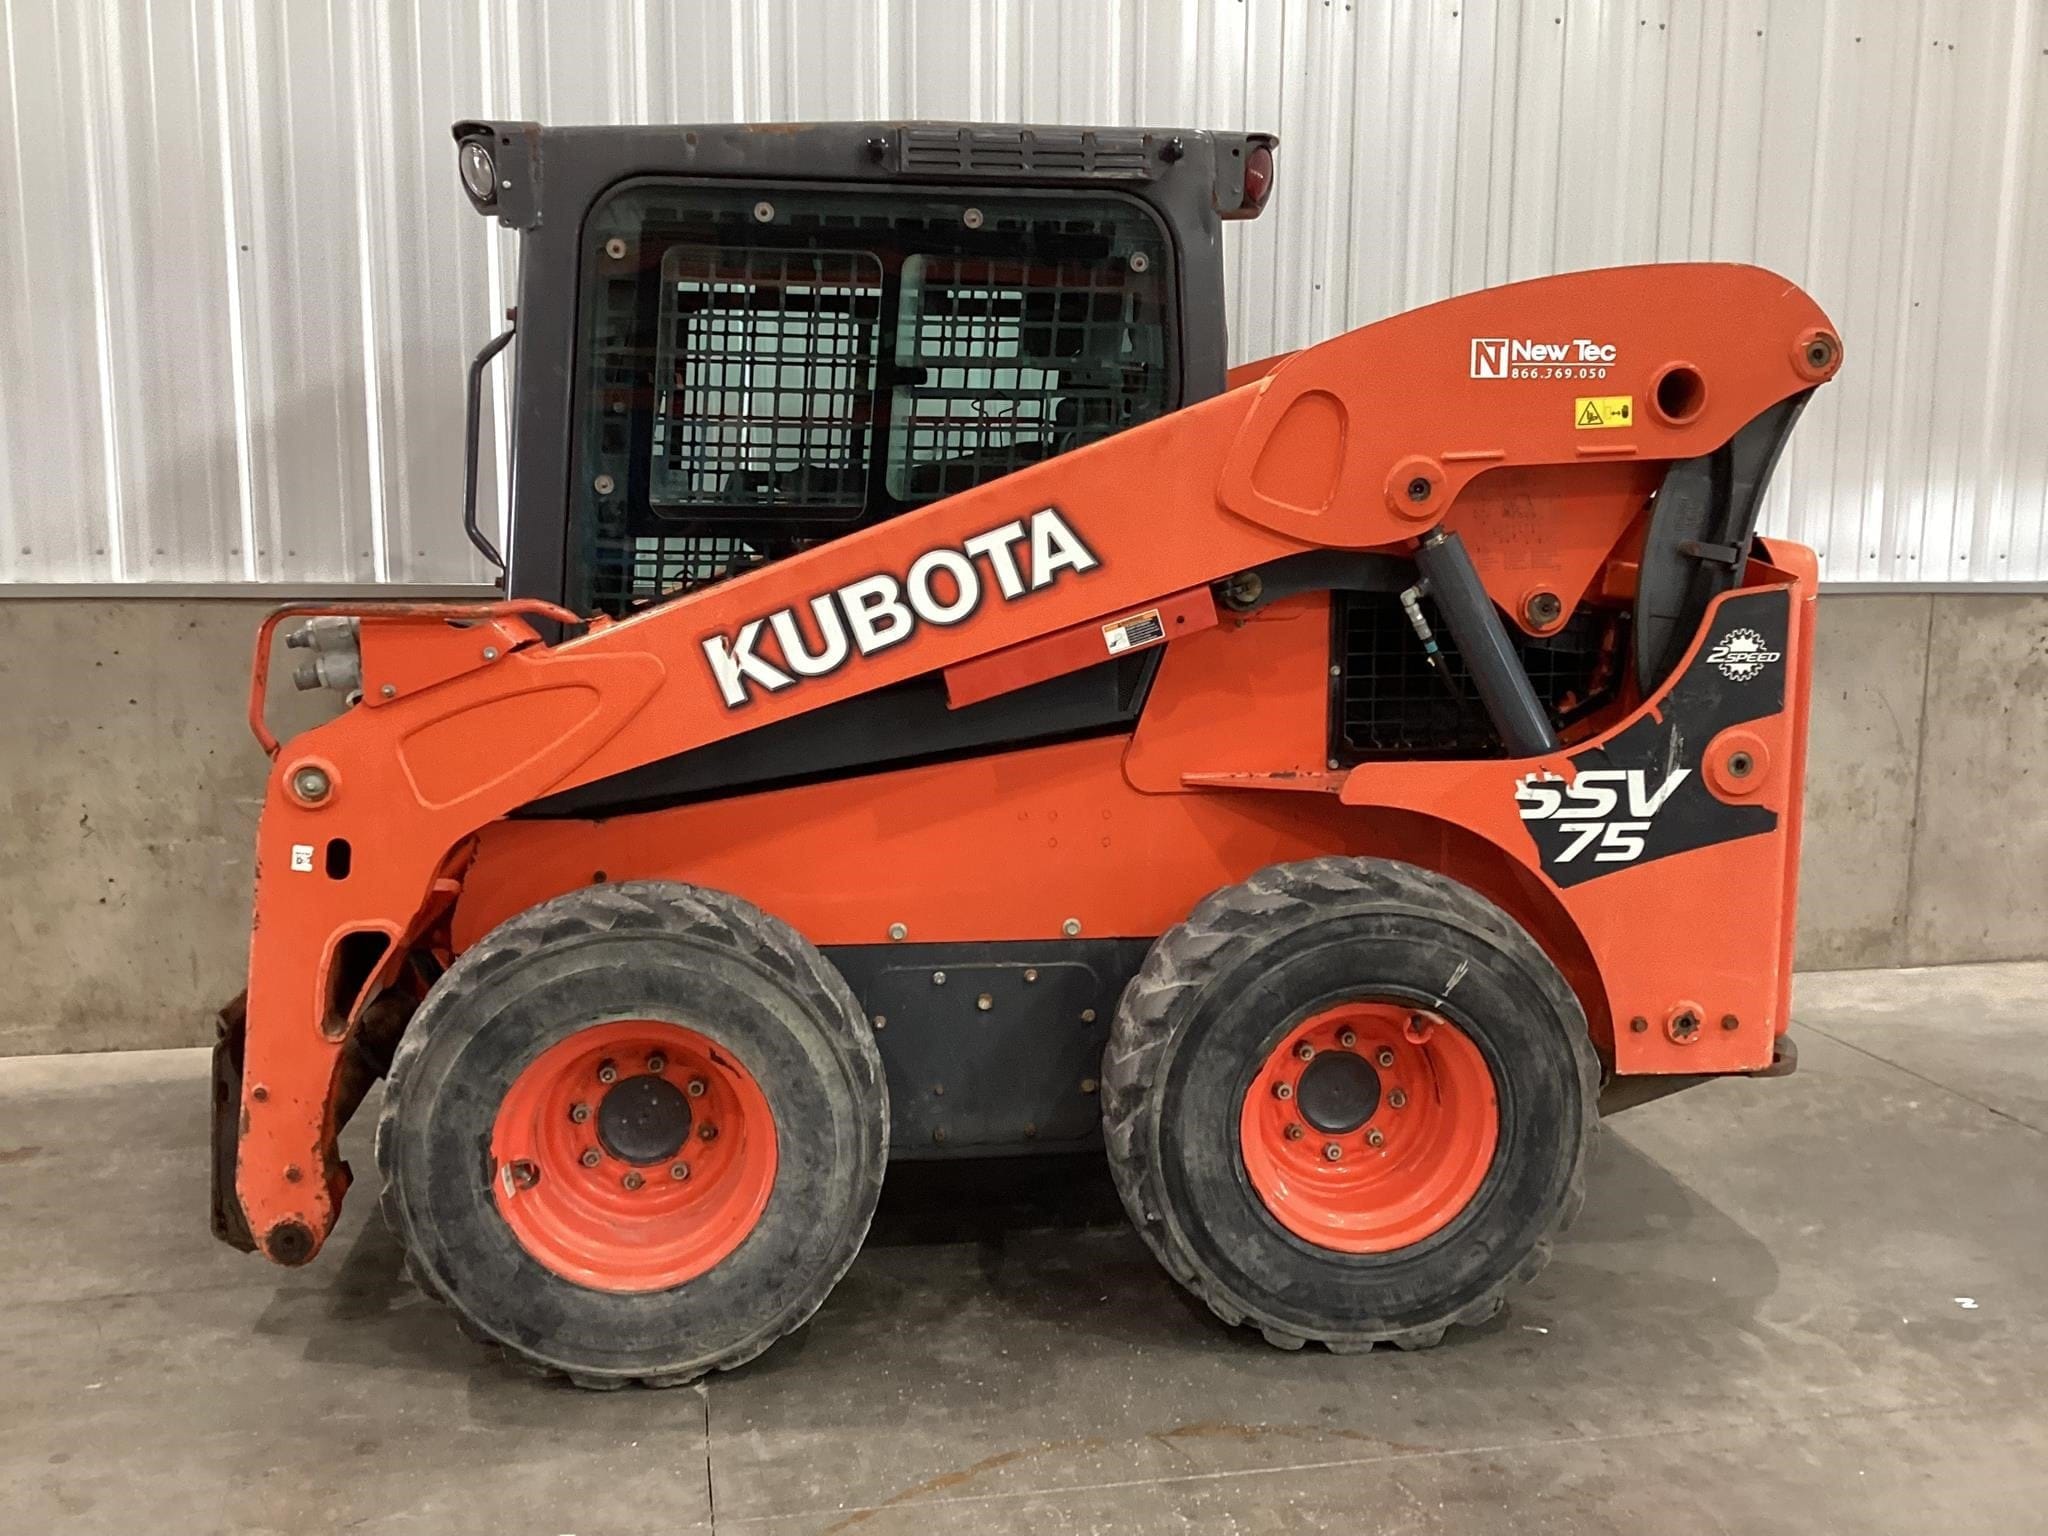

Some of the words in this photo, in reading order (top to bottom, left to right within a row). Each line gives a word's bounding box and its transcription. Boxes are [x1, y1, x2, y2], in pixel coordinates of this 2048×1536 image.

[1512, 339, 1570, 361] New
[1573, 340, 1617, 361] Tec
[702, 508, 1099, 707] KUBOTA
[1514, 769, 1692, 819] SSV
[1554, 822, 1651, 862] 75
